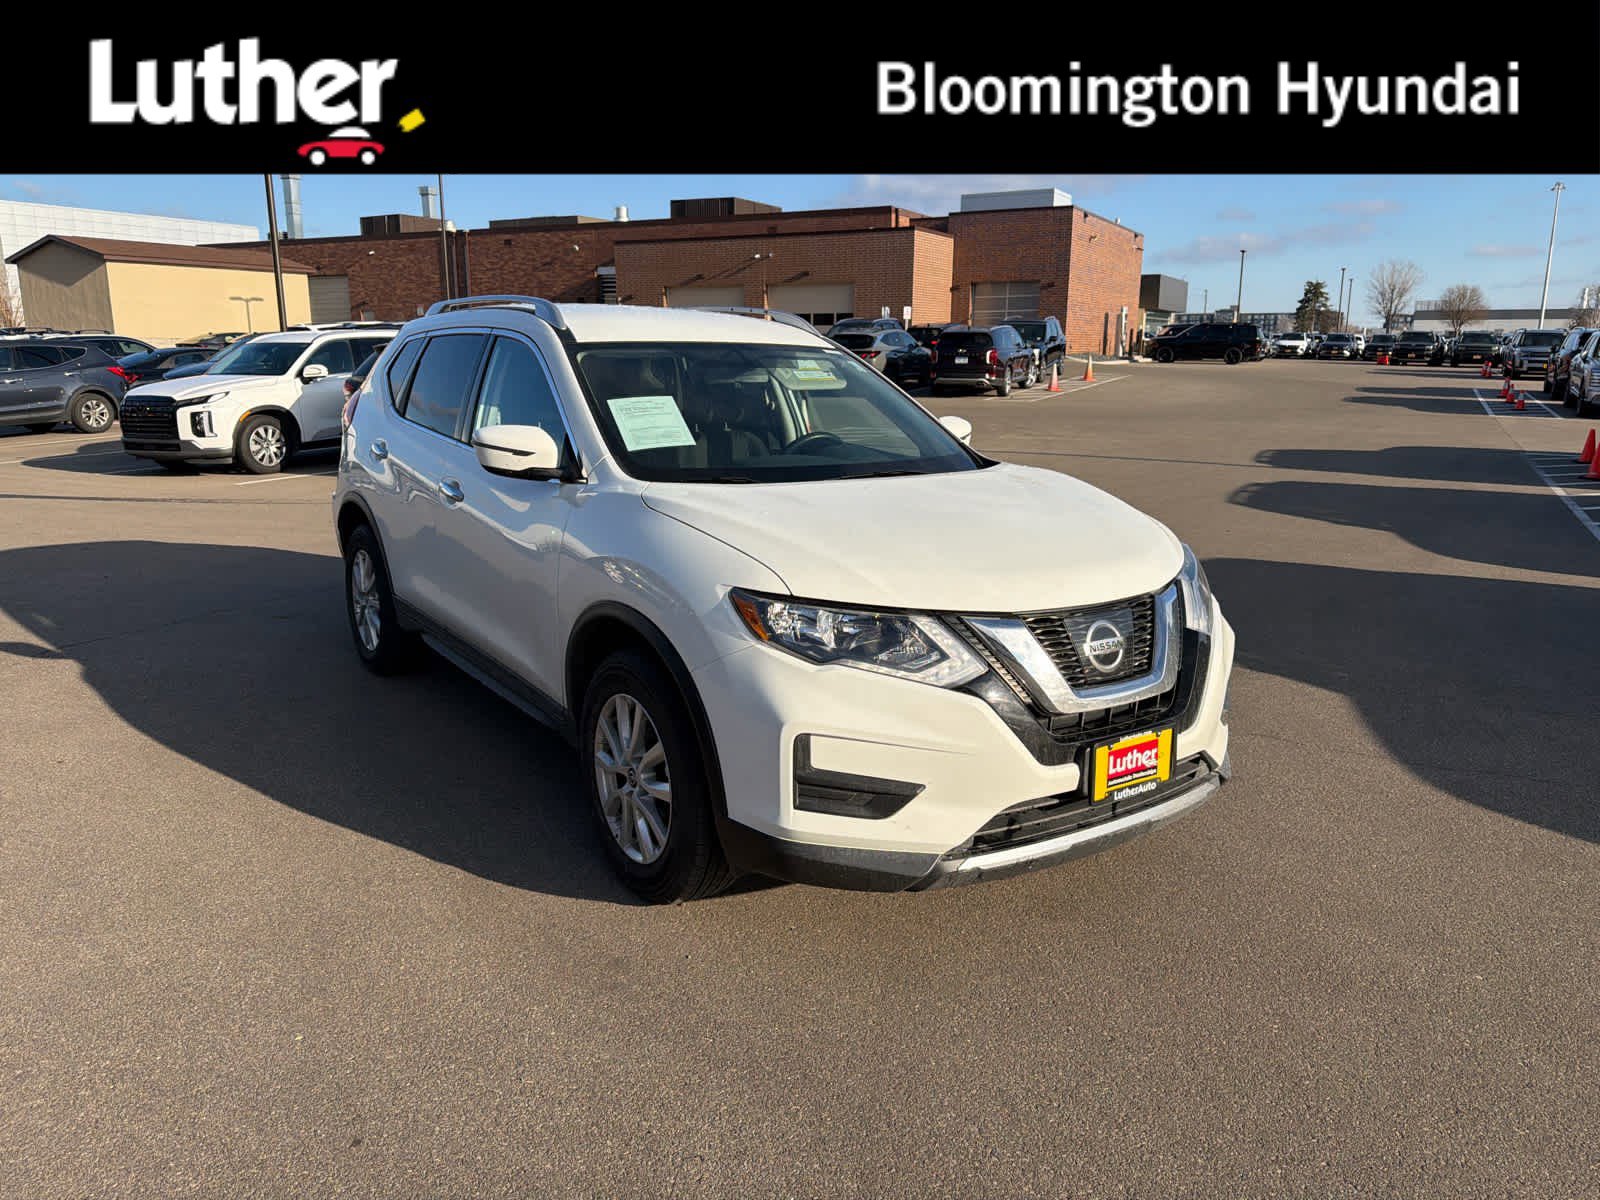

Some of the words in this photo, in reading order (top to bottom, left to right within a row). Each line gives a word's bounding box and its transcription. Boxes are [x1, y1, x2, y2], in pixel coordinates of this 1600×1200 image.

[1088, 639, 1123, 654] NISSAN
[1108, 747, 1158, 775] Luther
[1113, 781, 1157, 800] LutherAuto
